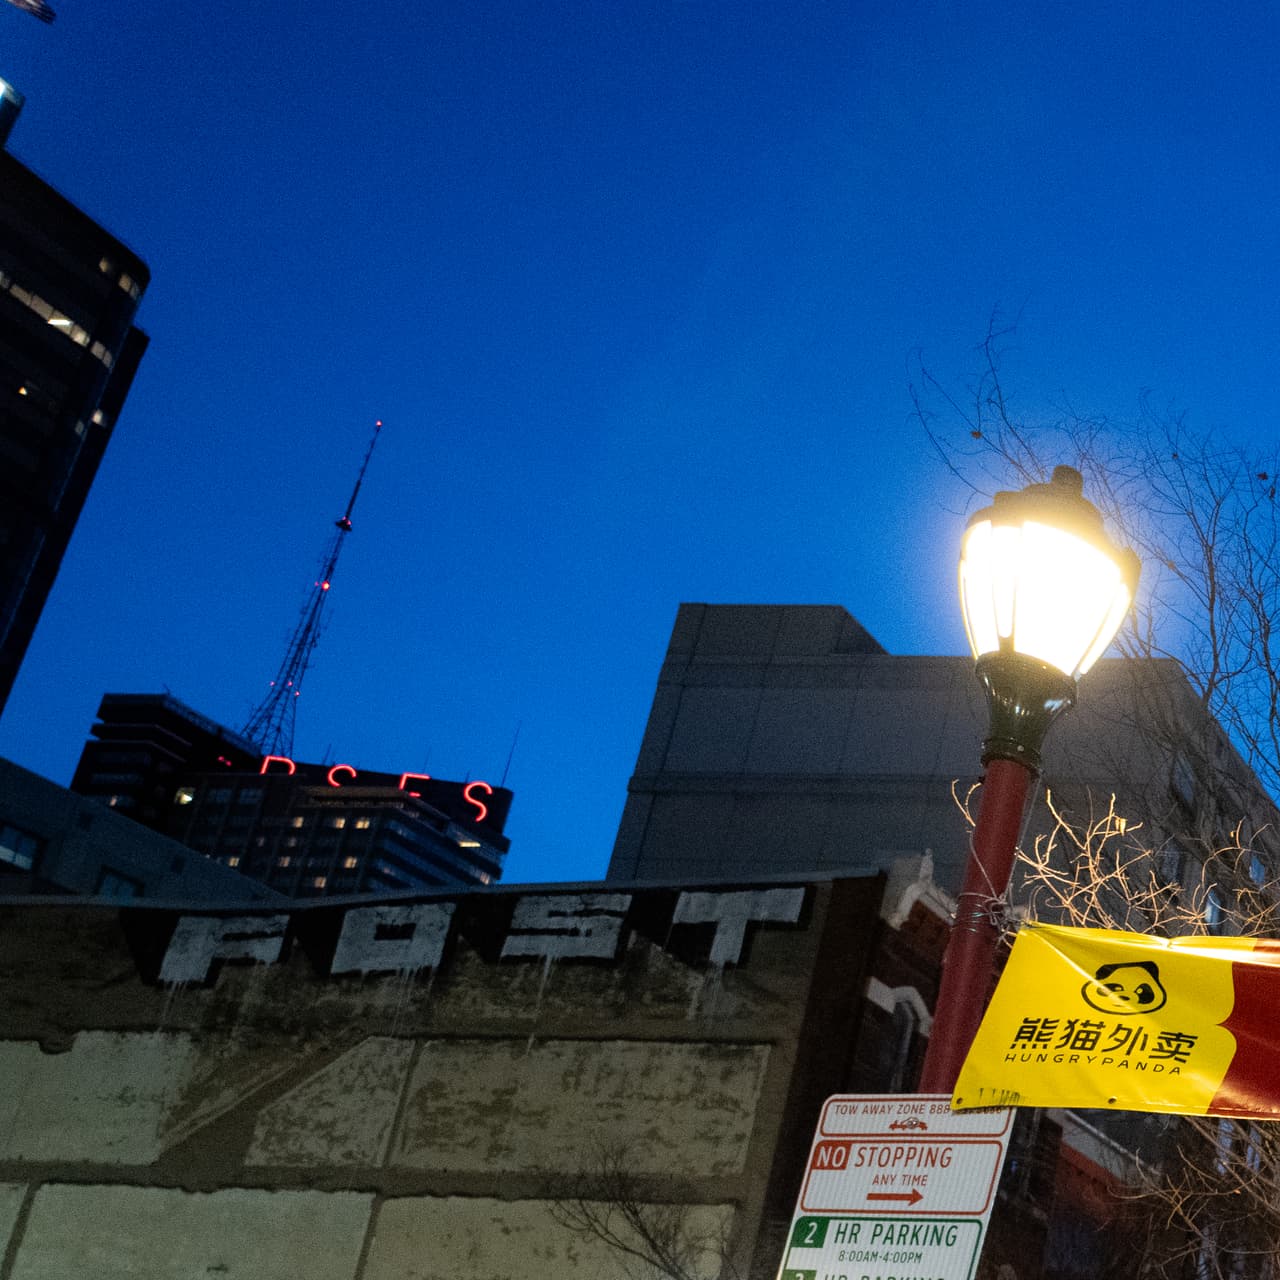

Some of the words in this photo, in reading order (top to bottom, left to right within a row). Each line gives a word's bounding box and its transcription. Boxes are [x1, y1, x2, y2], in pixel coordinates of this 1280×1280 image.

[1009, 1016, 1199, 1064] 熊猫外卖
[1004, 1053, 1182, 1076] HUNGRYPANDA
[835, 1104, 857, 1115] TOW
[861, 1104, 893, 1115] AWAY
[897, 1104, 925, 1115] ZONE
[816, 1146, 847, 1168] NO
[854, 1146, 953, 1169] STOPPING
[872, 1174, 899, 1186] ANY
[902, 1174, 929, 1187] TIME
[803, 1222, 818, 1244] 2
[834, 1223, 861, 1244] HR
[870, 1224, 959, 1247] PARKING
[838, 1250, 923, 1264] 8:00AM-4:00PM
